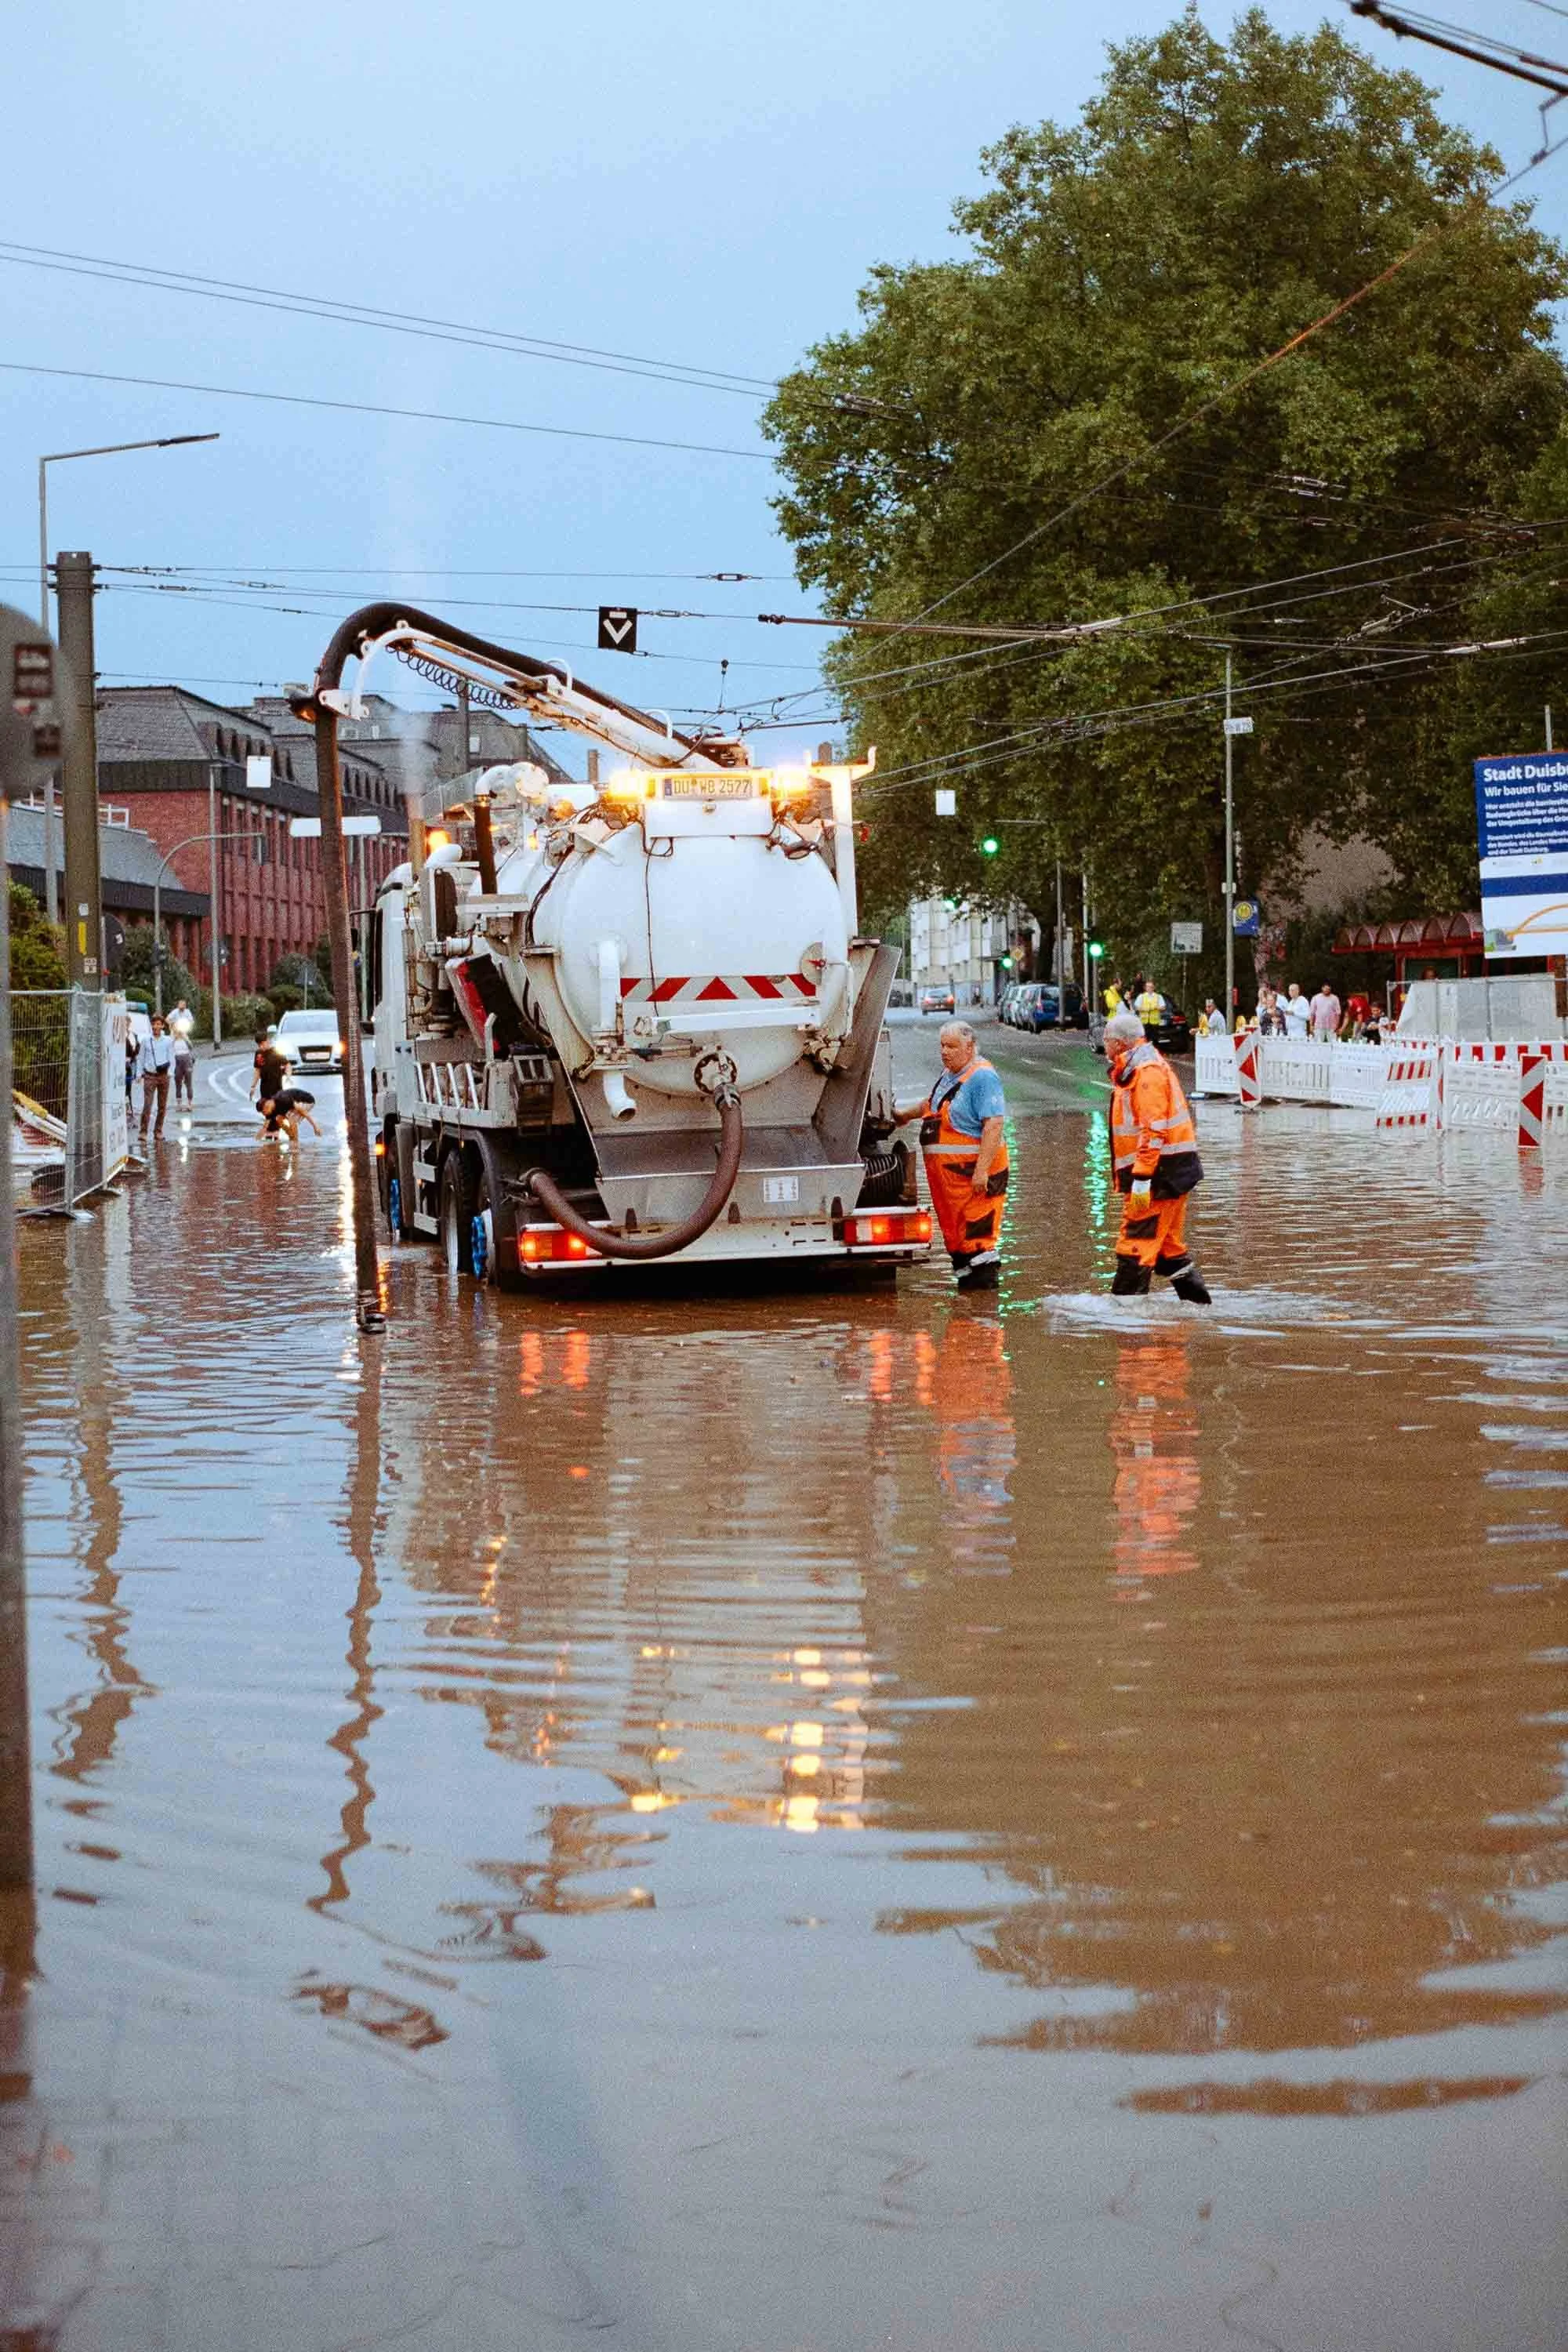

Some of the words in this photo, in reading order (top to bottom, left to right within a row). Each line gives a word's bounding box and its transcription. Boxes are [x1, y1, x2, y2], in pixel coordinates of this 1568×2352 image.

[1483, 766, 1523, 782] Stadt
[673, 780, 690, 793] DU
[720, 779, 749, 793] 2577
[1484, 786, 1502, 797] Wir
[1504, 785, 1535, 796] bauen
[1537, 782, 1552, 793] für
